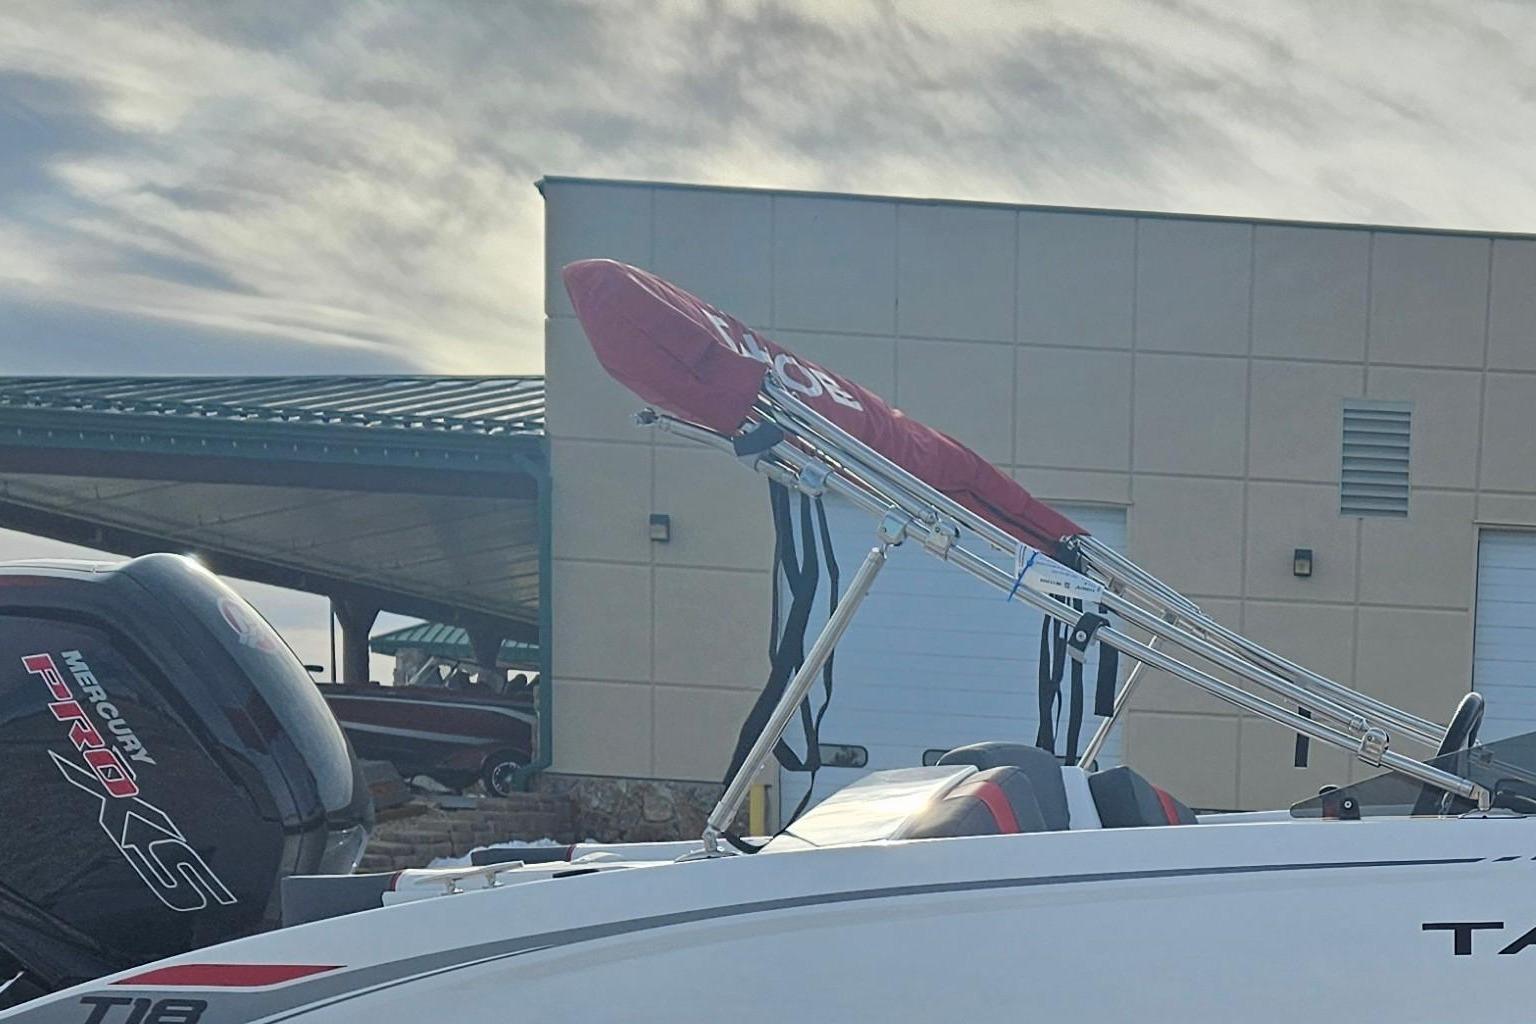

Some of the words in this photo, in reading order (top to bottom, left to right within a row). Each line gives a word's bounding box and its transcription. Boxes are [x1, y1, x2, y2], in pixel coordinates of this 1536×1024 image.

[21, 653, 139, 797] PRO
[61, 650, 156, 765] MERCURY
[47, 745, 238, 912] XS
